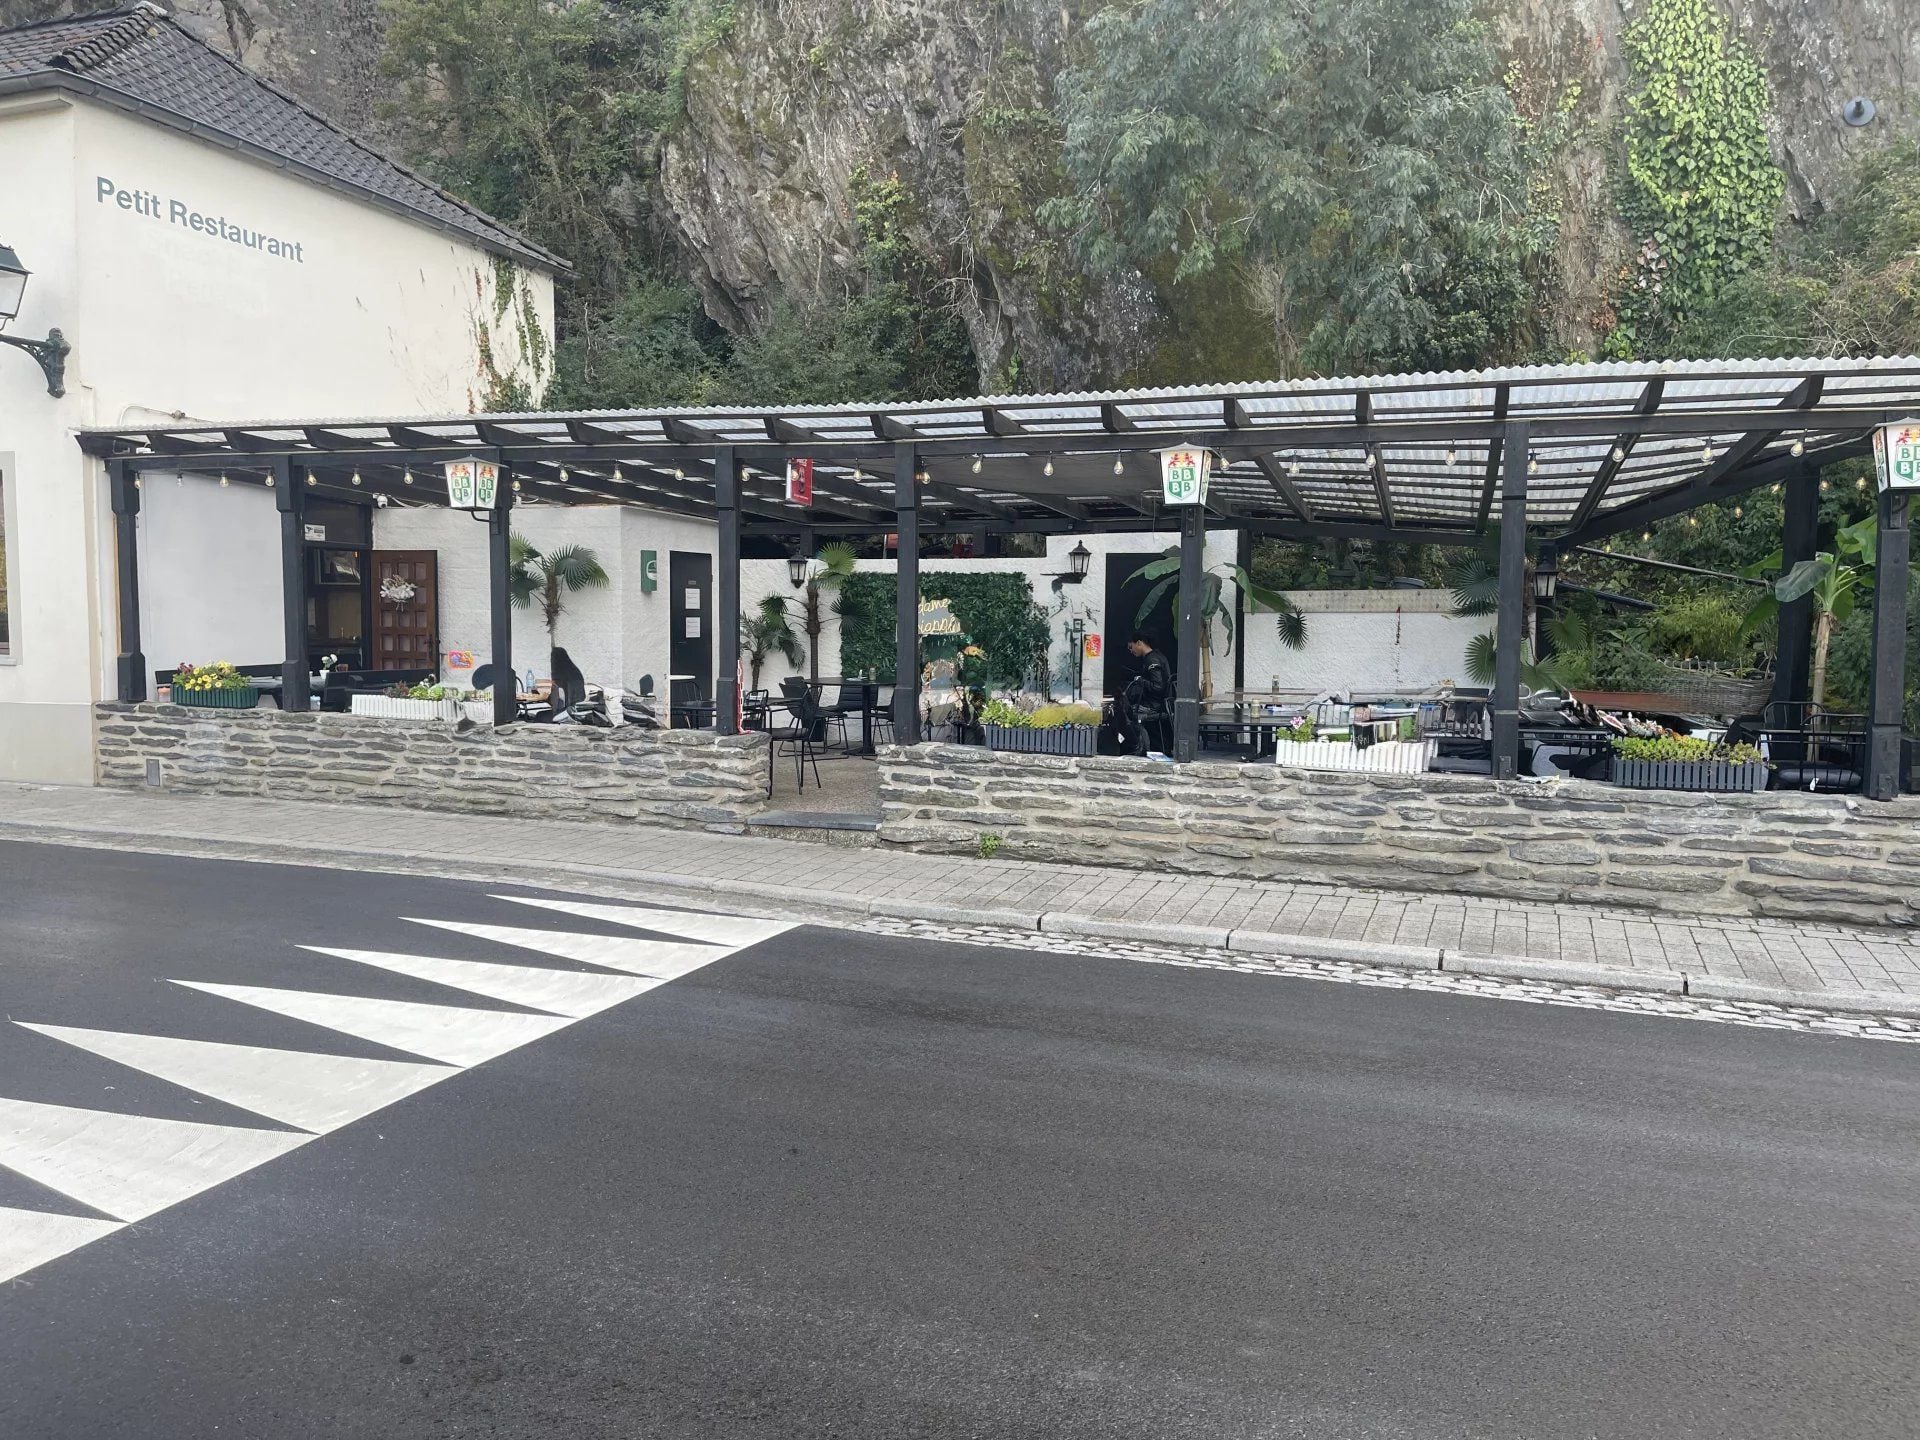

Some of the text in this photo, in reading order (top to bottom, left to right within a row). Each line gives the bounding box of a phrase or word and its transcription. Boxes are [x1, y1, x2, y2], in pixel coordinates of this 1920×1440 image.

[97, 176, 161, 219] Petit
[169, 199, 304, 264] Restaurant
[918, 596, 953, 616] dame
